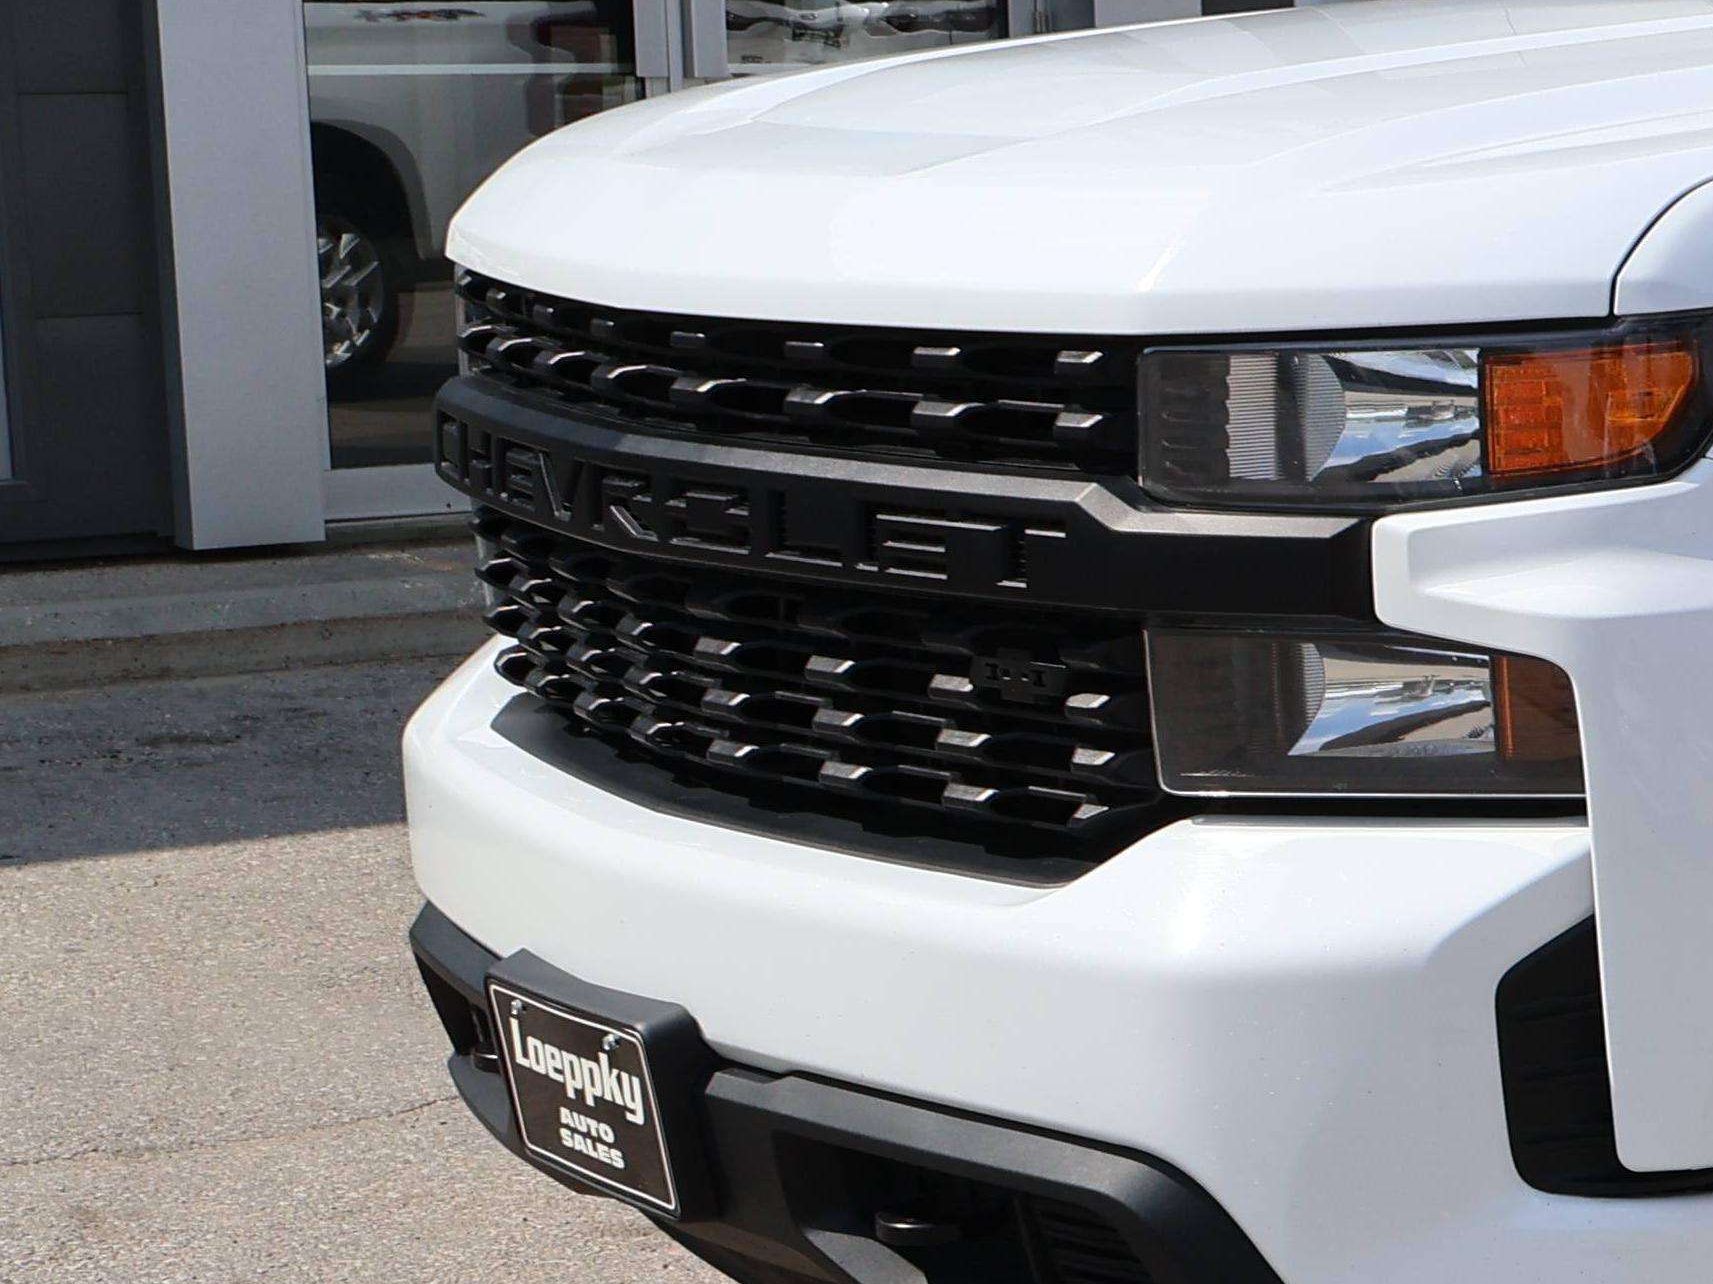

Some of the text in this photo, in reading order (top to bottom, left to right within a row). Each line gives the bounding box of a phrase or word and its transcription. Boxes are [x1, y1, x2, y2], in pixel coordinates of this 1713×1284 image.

[509, 1017, 645, 1126] Loeppky
[560, 1106, 615, 1143] AUTO
[560, 1128, 626, 1169] SALES
